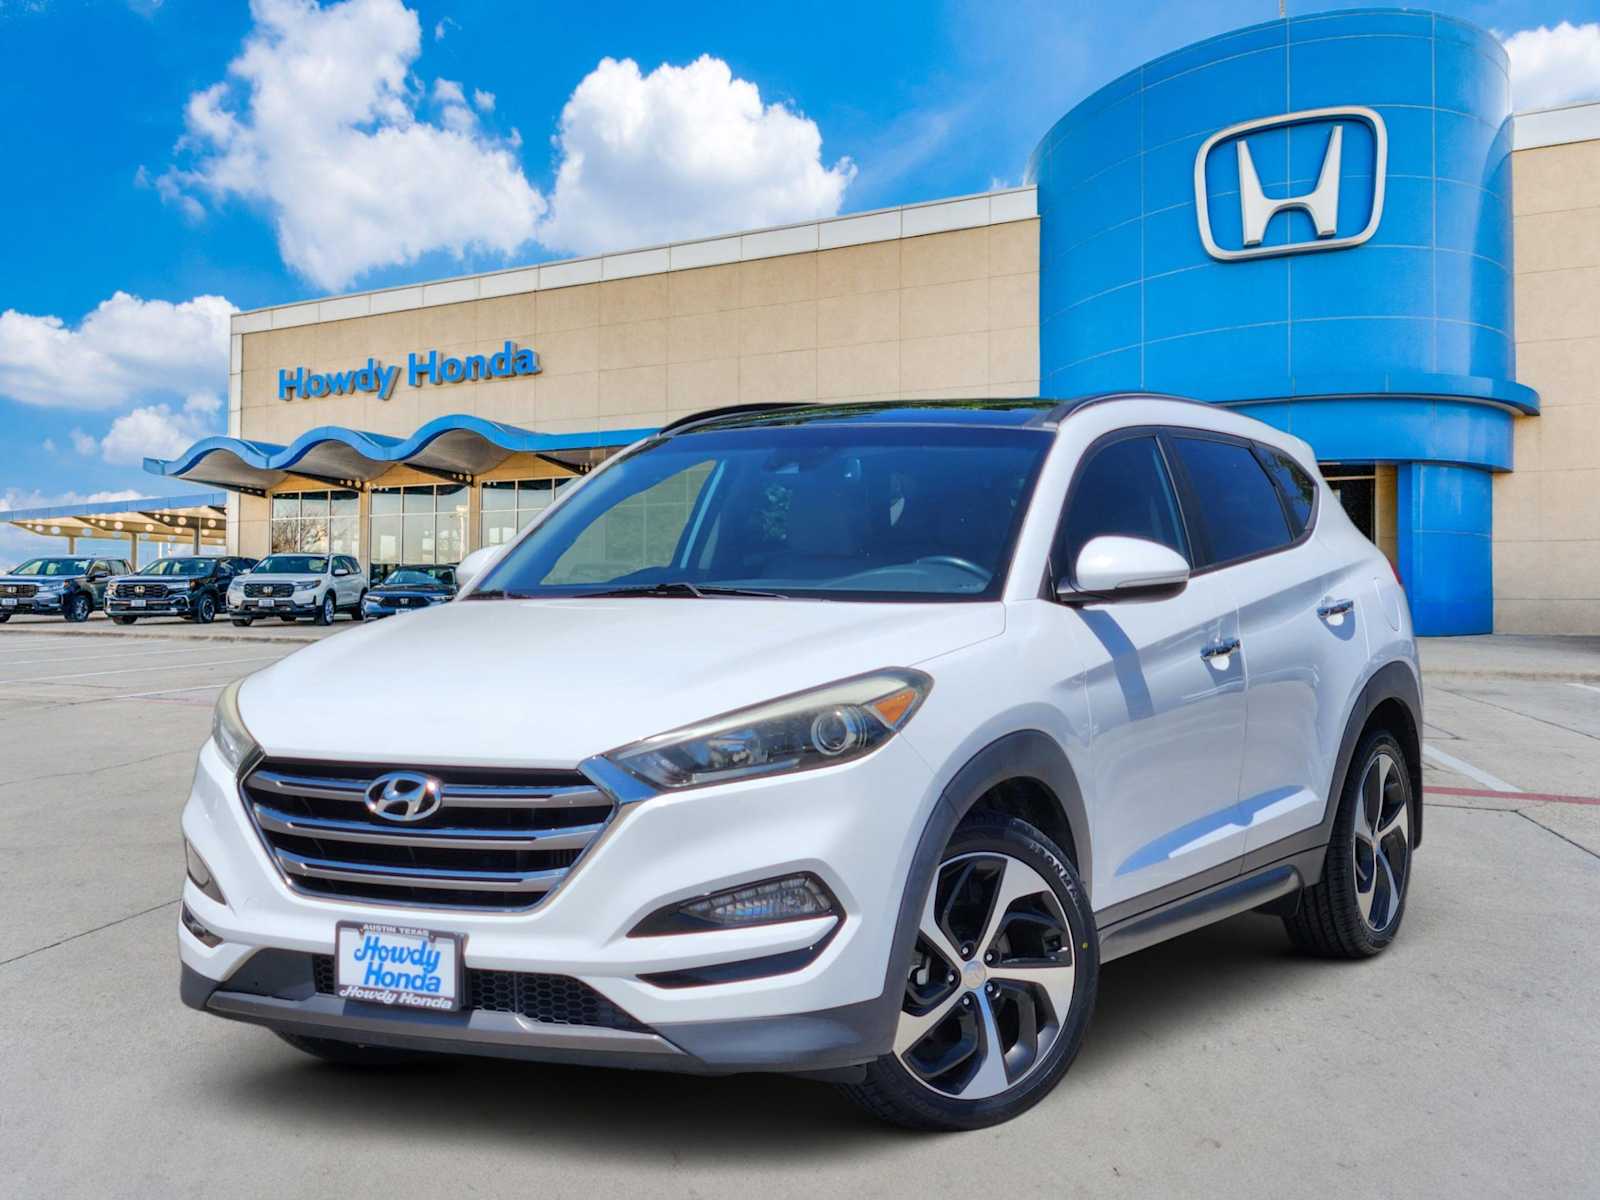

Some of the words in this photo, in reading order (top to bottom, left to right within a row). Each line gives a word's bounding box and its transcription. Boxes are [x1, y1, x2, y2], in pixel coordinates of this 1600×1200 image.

[279, 358, 400, 400] Howdy
[408, 340, 542, 387] Honda
[1029, 842, 1082, 903] IRONMA
[364, 924, 396, 934] AUSTIN
[400, 927, 429, 937] TEXAS
[354, 936, 441, 973] Howdy
[364, 962, 441, 992] Honda
[340, 986, 397, 1004] Howdy
[399, 992, 453, 1009] Honda
